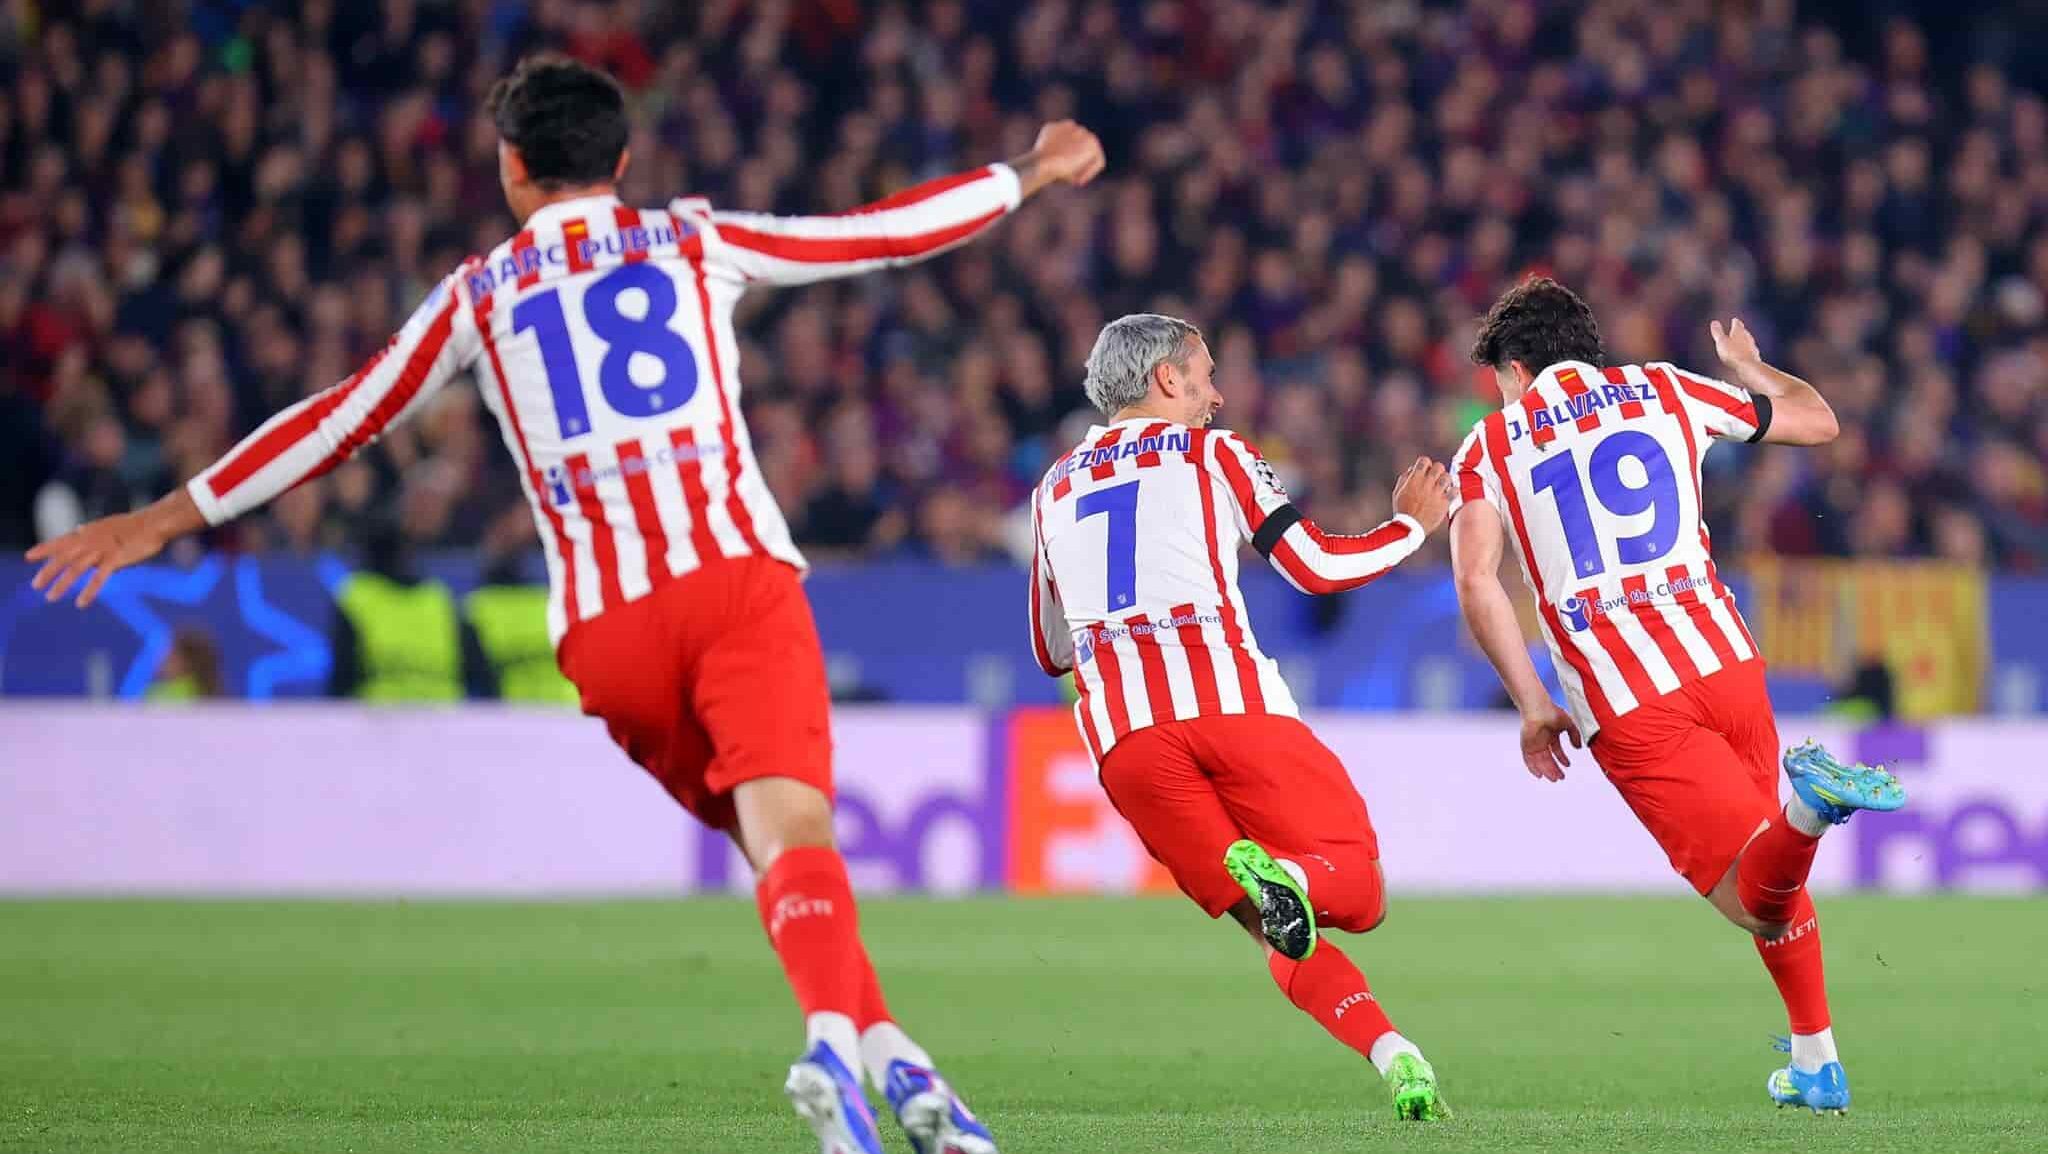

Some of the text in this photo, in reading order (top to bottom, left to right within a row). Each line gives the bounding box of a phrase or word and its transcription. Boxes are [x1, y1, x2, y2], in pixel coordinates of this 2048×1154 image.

[468, 246, 562, 302] MARC
[512, 262, 698, 440] 18
[1507, 384, 1656, 441] J. ALVAREZ
[1044, 432, 1190, 493] RIEZMANN
[1531, 430, 1680, 579] 19
[1076, 480, 1140, 613] 7
[1595, 595, 1628, 613] Save
[1631, 588, 1654, 602] the
